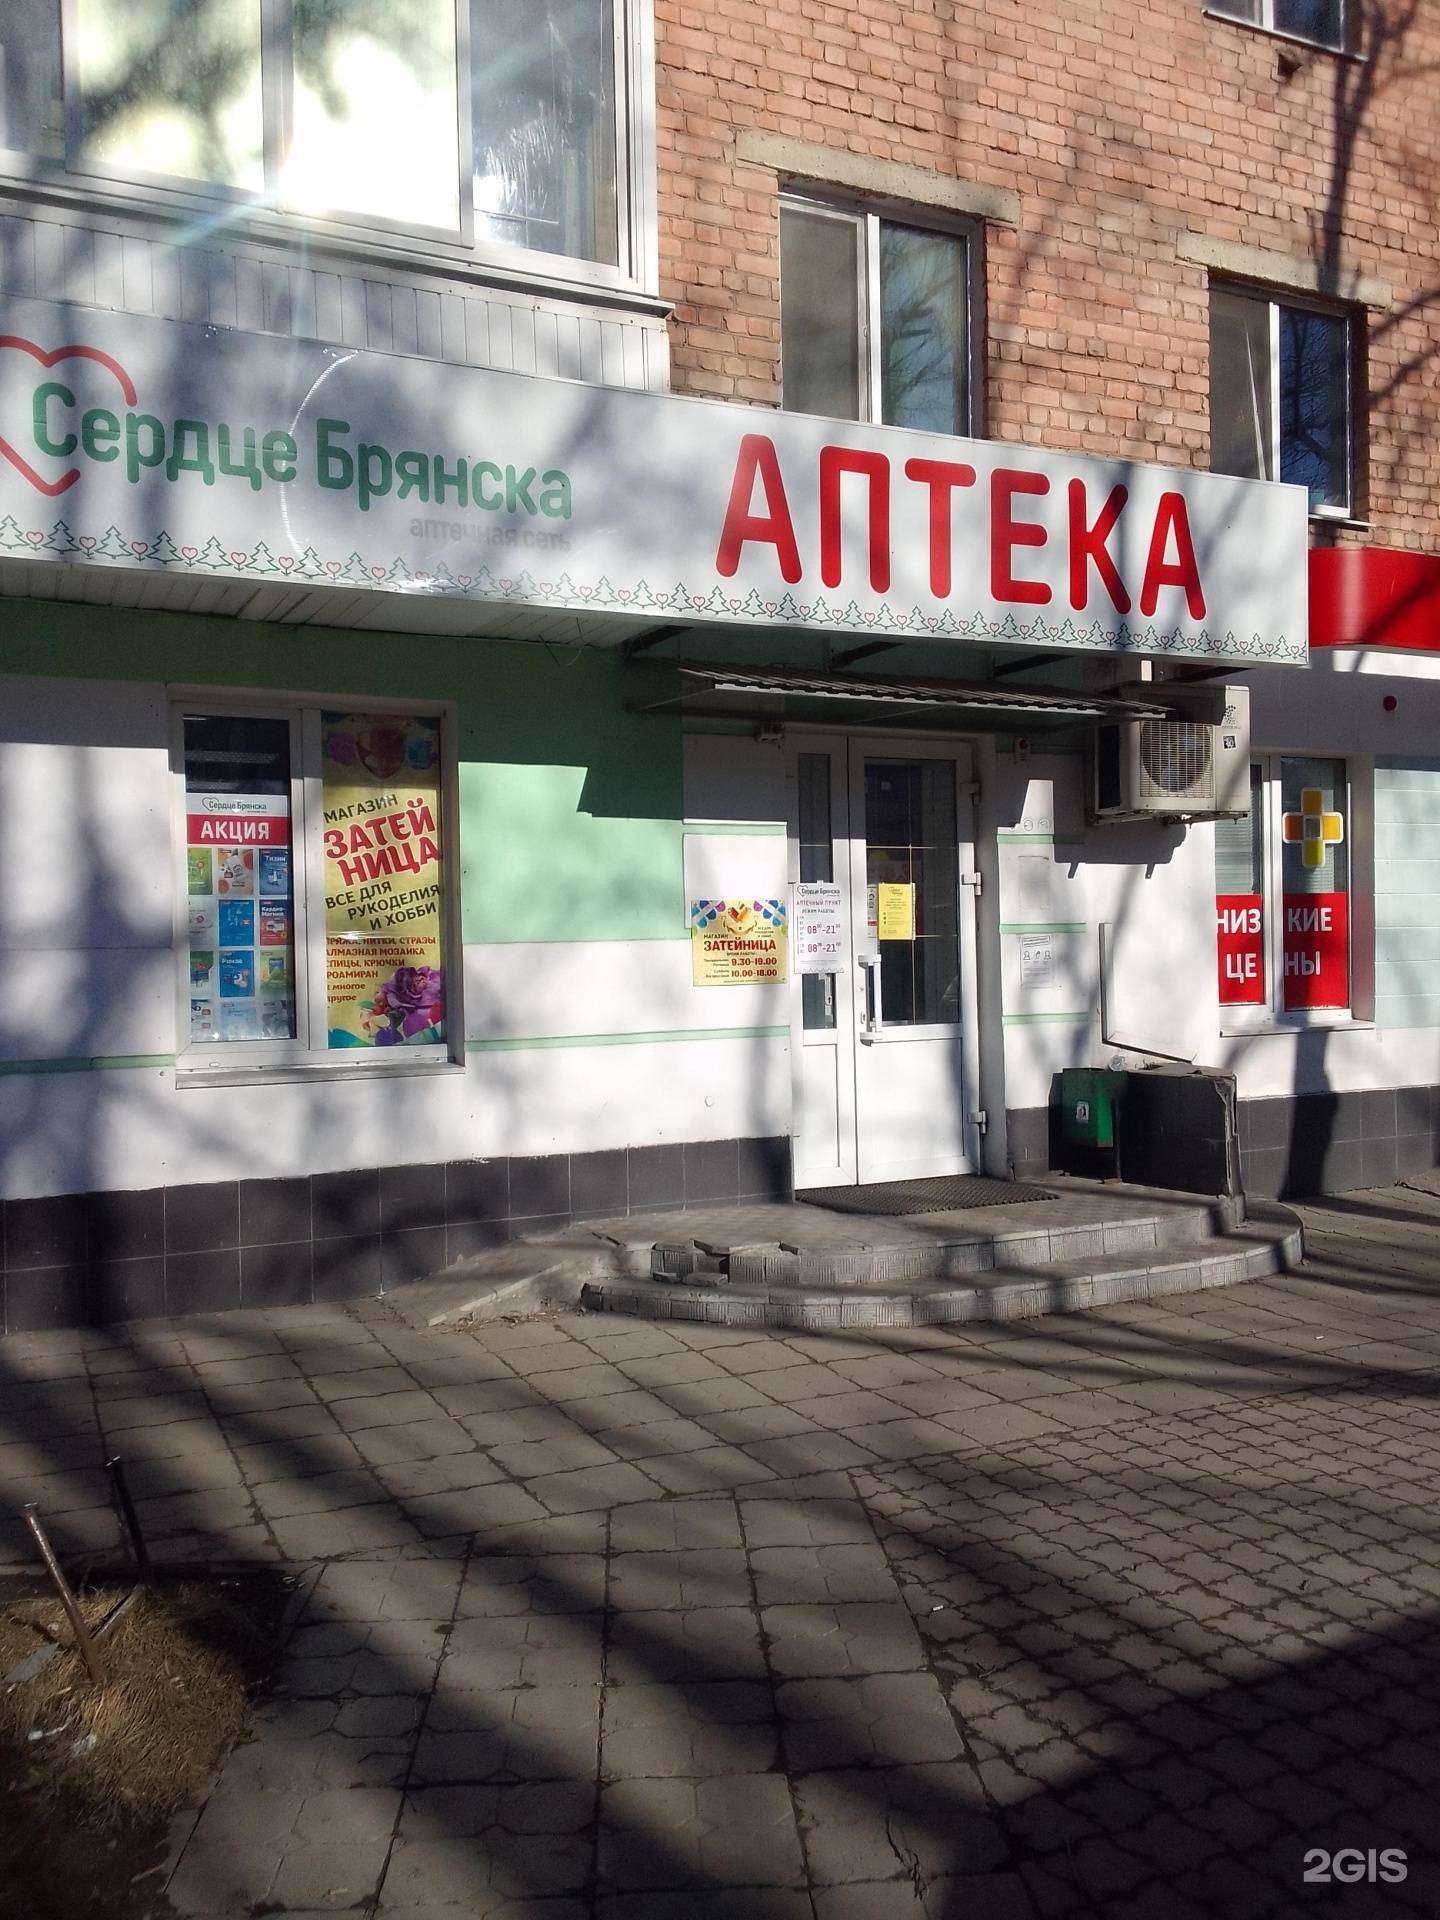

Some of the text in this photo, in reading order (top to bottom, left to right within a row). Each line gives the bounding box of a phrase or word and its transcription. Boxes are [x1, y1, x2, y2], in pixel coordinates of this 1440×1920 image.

[32, 382, 573, 520] Сердце Брянска
[715, 433, 1207, 621] АПТЕКА
[323, 794, 398, 823] МАГАЗИН
[200, 820, 269, 843] АКЦИЯ
[323, 797, 436, 858] ЗАТЕЙ
[337, 837, 442, 886] НИЦА
[325, 881, 392, 909] ВСЕ ДЛЯ
[348, 884, 440, 920] РУКОДЕЛИЯ
[370, 902, 436, 930] И ХОББИ
[1216, 907, 1332, 934] НИЗ КИЕ
[704, 937, 776, 952] ЗАТЕЙНИЦА
[327, 959, 361, 968] ПИЦЫ,
[1226, 951, 1320, 984] ЦЕ НЫ
